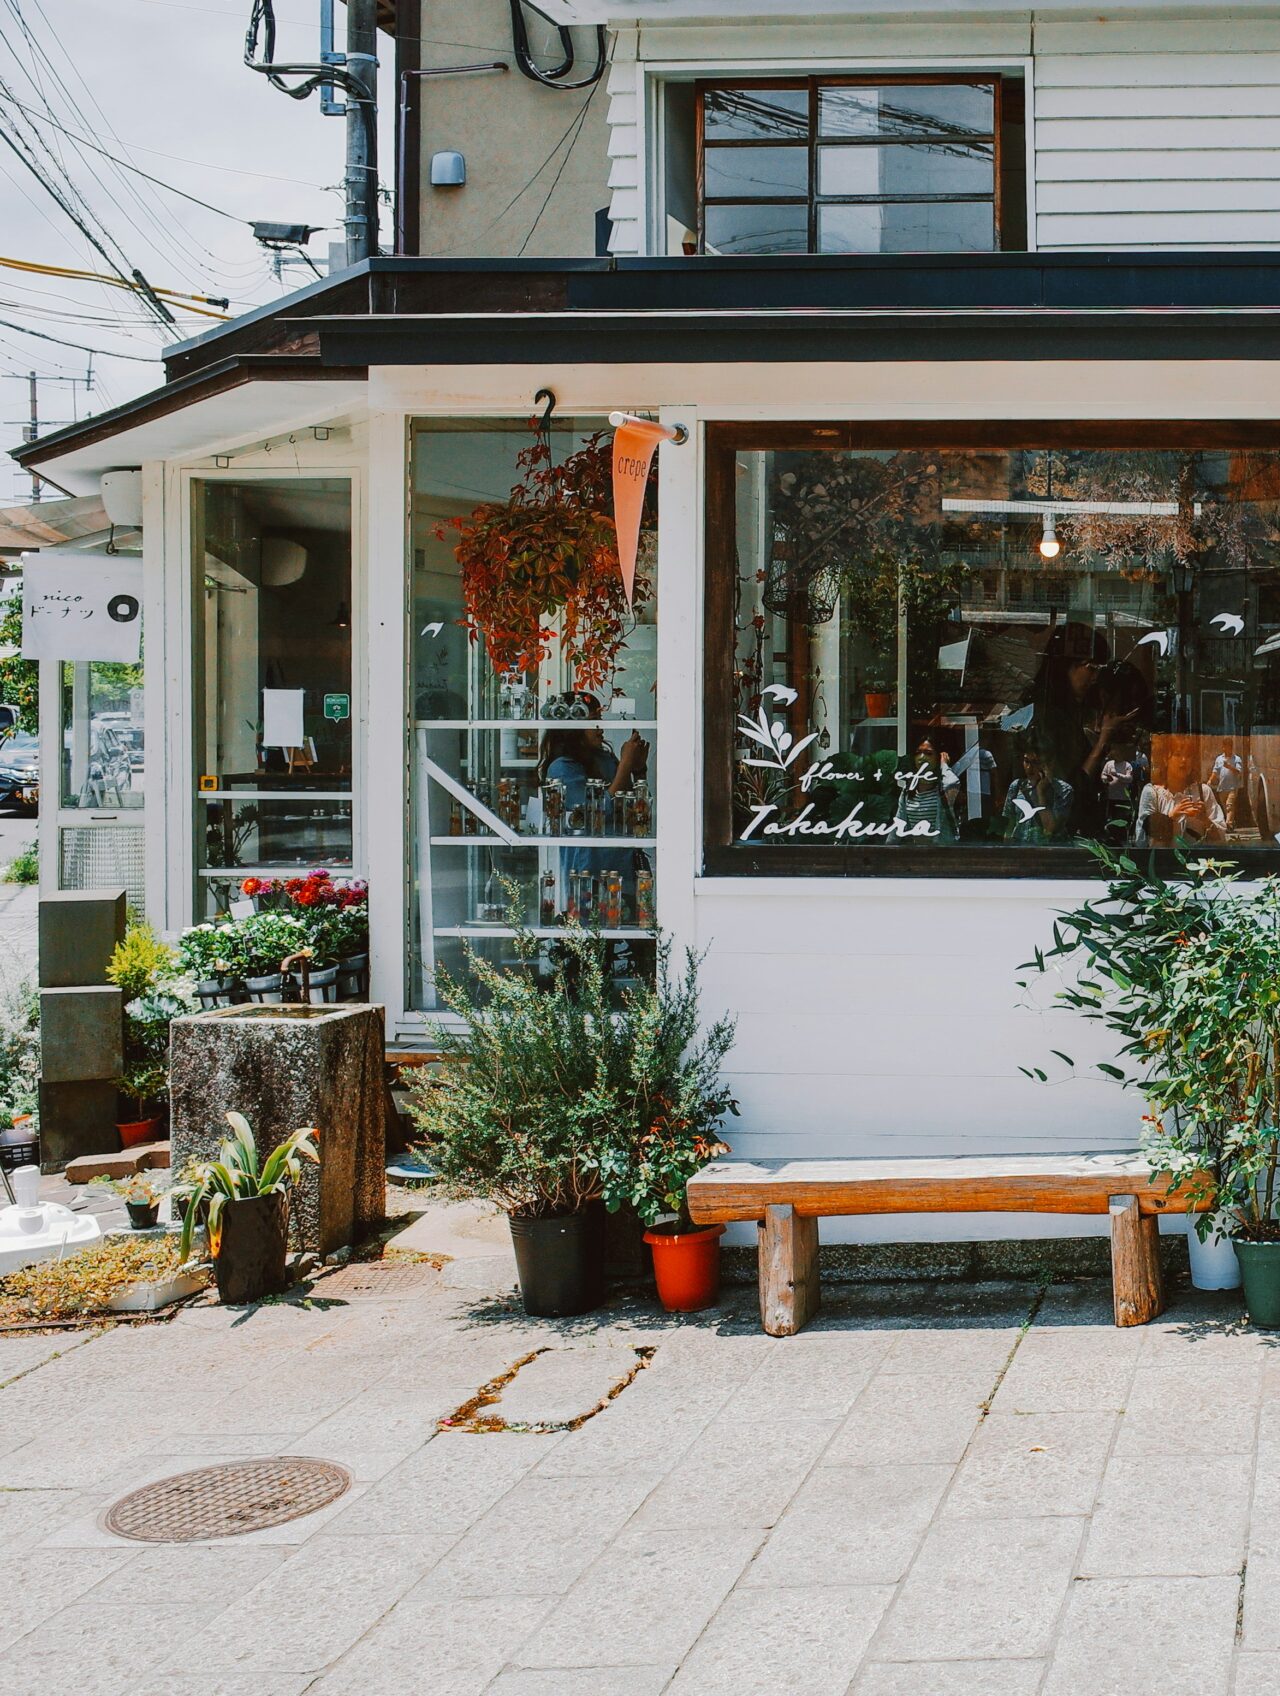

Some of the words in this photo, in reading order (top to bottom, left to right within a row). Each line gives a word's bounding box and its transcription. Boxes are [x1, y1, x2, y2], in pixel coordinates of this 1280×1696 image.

[618, 456, 647, 482] crepe
[43, 590, 84, 602] nico
[31, 605, 94, 620] ドーナツ
[799, 762, 865, 792] flower
[873, 768, 883, 782] +
[894, 762, 938, 791] cafe
[740, 801, 941, 841] Takakura
